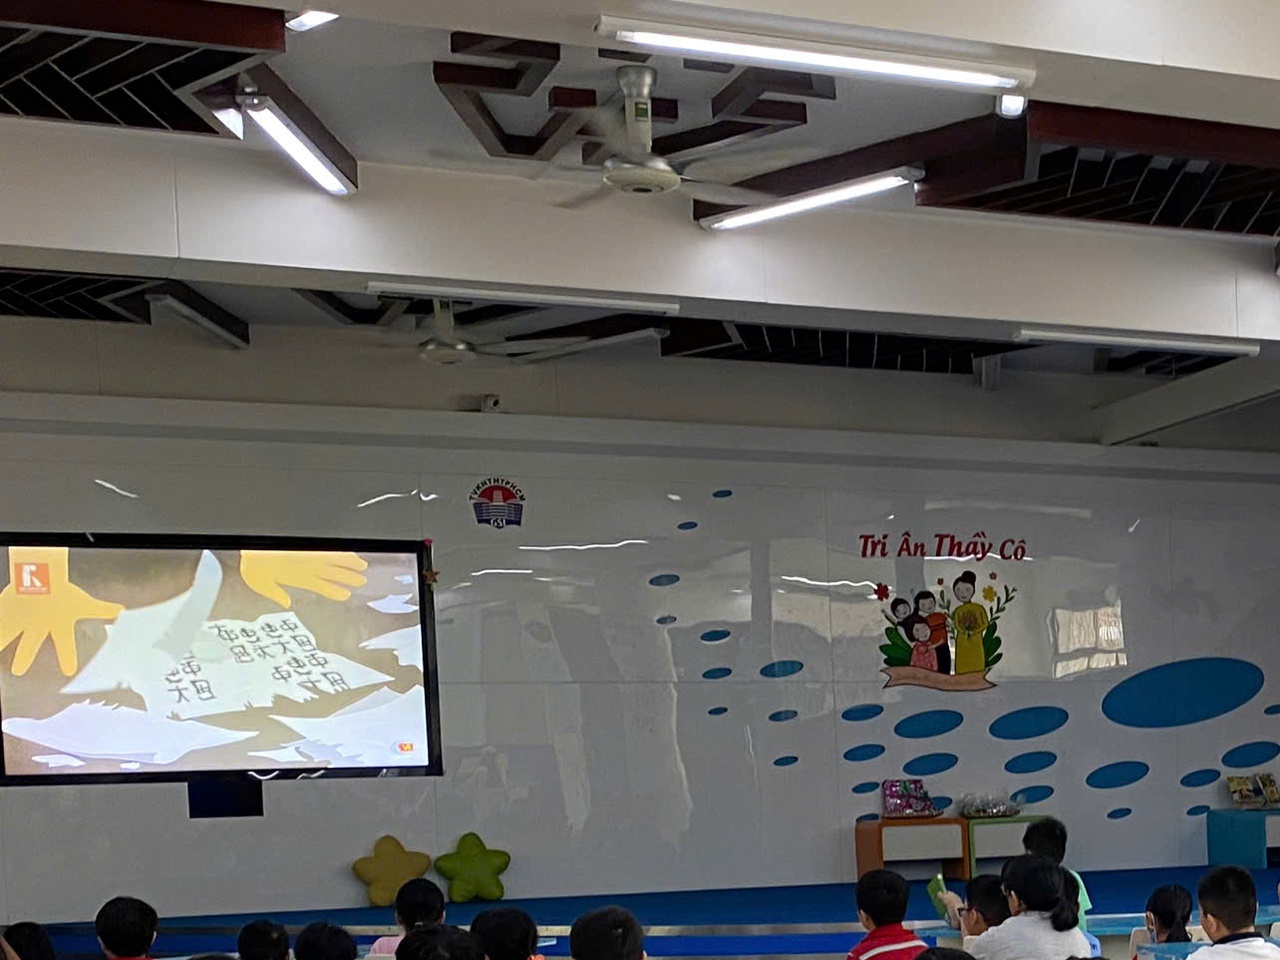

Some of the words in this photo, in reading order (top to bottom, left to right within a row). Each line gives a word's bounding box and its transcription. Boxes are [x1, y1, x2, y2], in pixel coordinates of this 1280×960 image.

[897, 531, 926, 557] Ân
[934, 531, 993, 562] Thầy
[999, 538, 1027, 560] Cô
